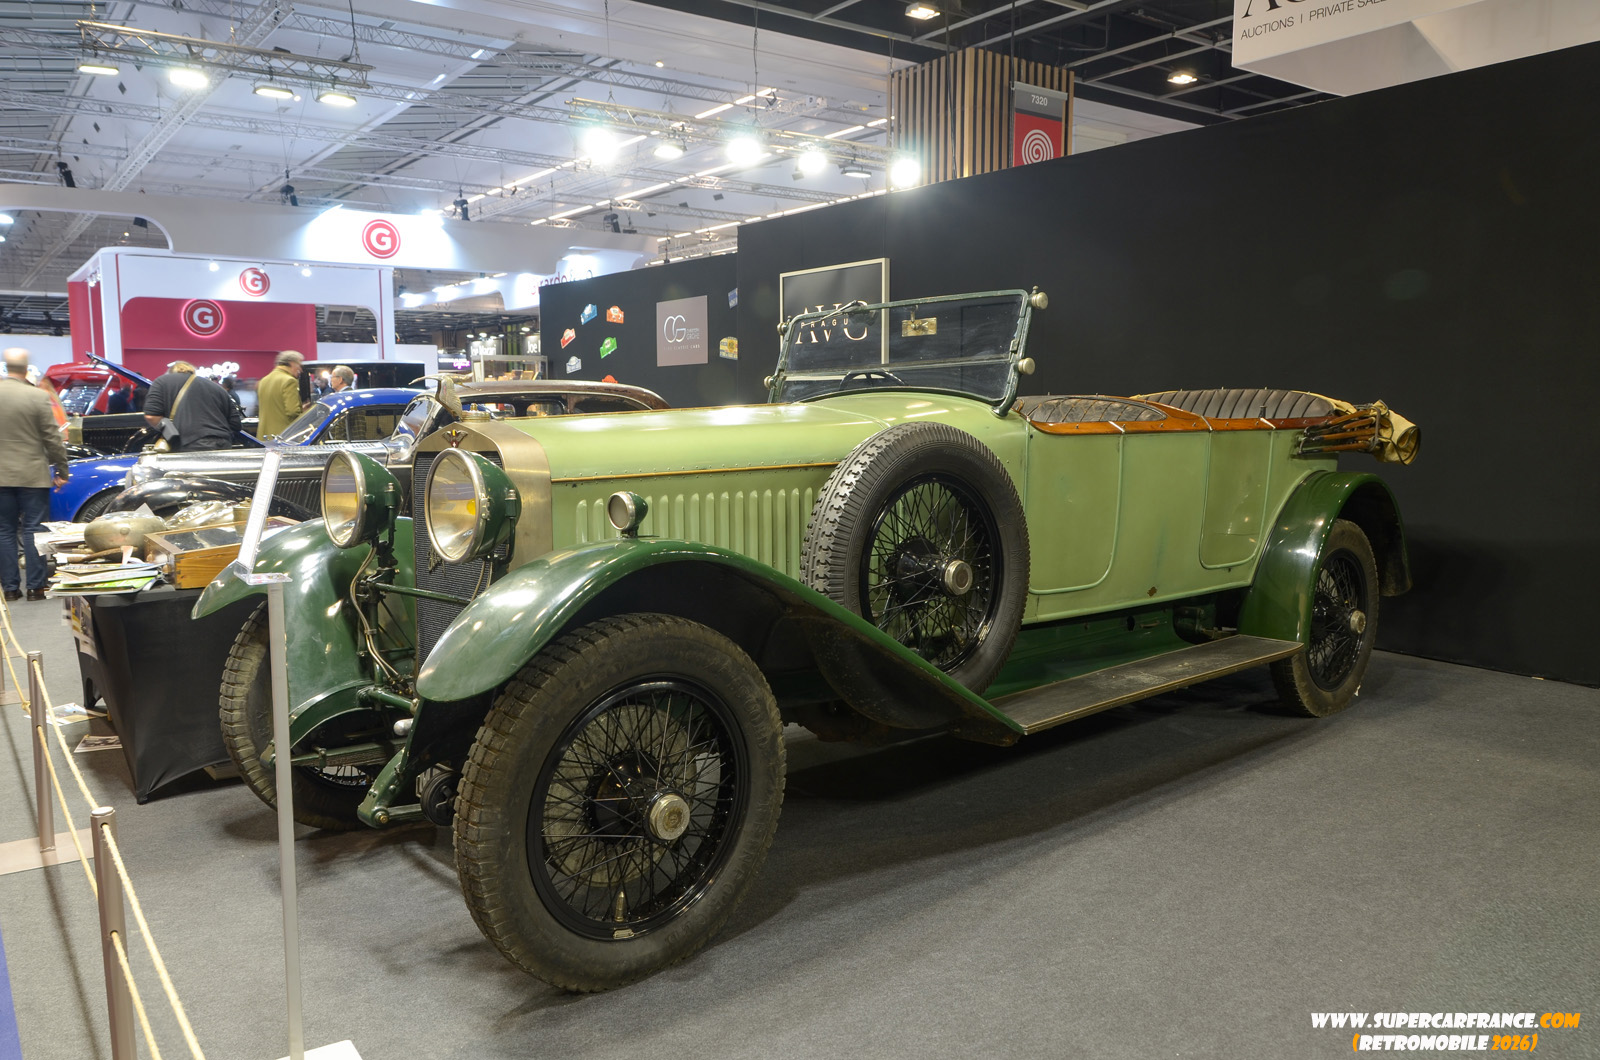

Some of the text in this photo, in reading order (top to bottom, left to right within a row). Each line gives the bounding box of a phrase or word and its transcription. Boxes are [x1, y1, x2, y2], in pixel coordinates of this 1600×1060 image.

[1240, 16, 1295, 40] AUCTIONS
[1309, 0, 1354, 21] PRIVATE
[1031, 94, 1048, 106] 7320
[370, 227, 392, 251] G
[192, 307, 214, 328] G
[800, 318, 849, 329] PRAGU
[526, 340, 537, 354] Joe
